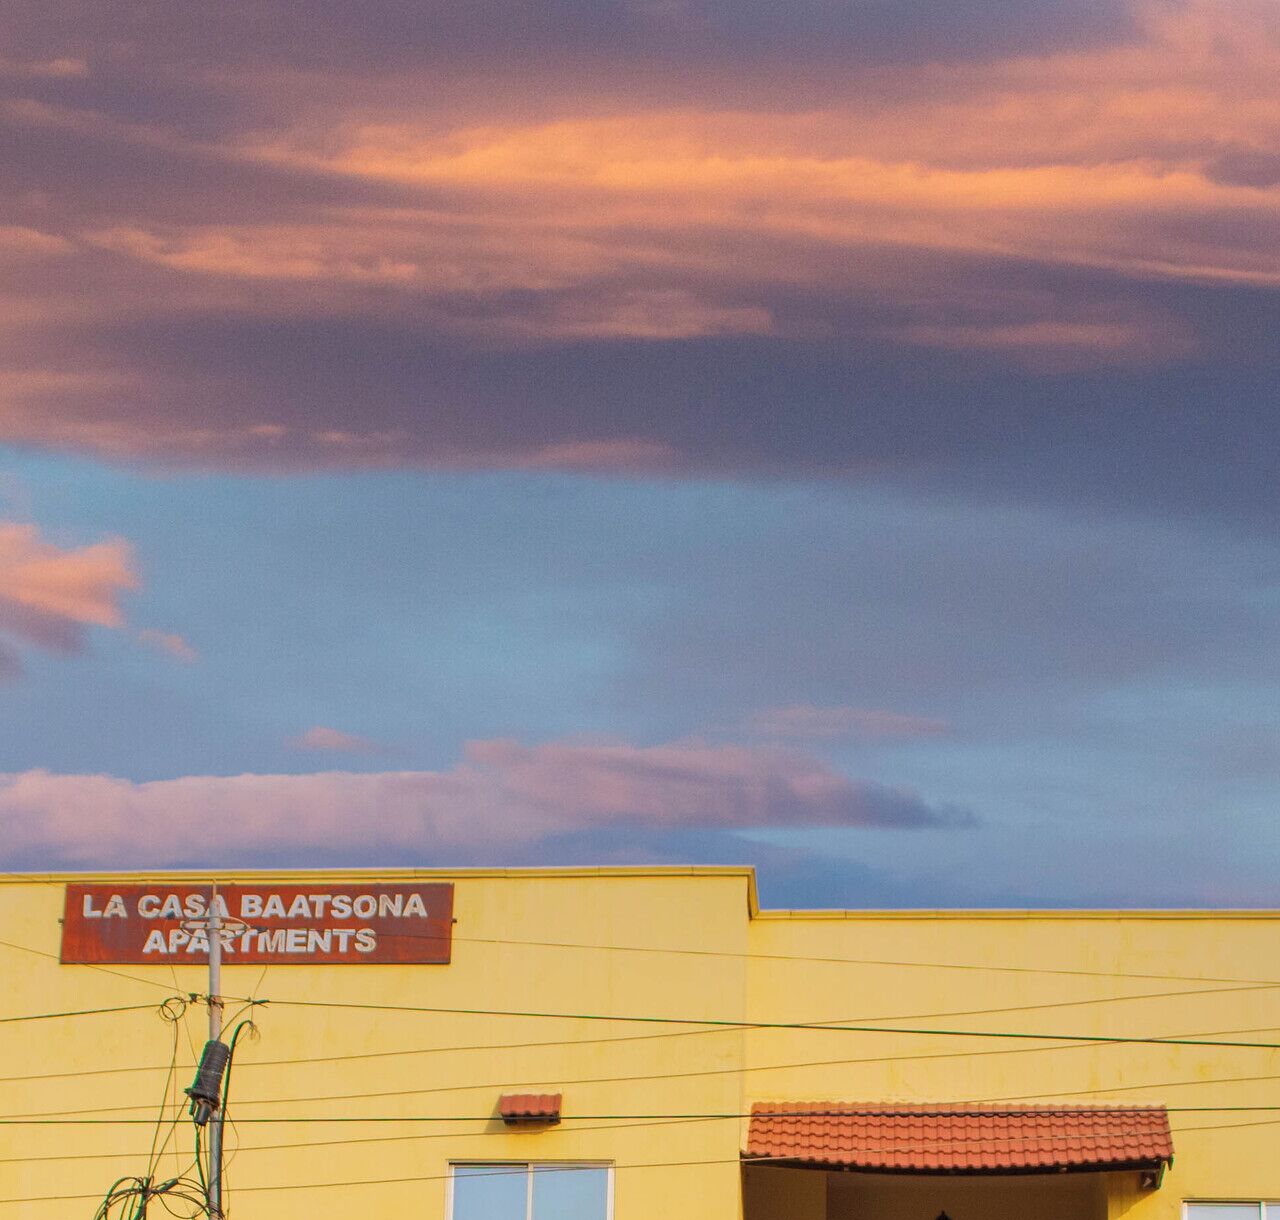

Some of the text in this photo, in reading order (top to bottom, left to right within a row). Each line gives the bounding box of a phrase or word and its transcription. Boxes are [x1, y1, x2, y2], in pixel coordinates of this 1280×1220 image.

[83, 893, 428, 919] LA CASA BAATSONA
[143, 928, 377, 954] APARTMENTS
